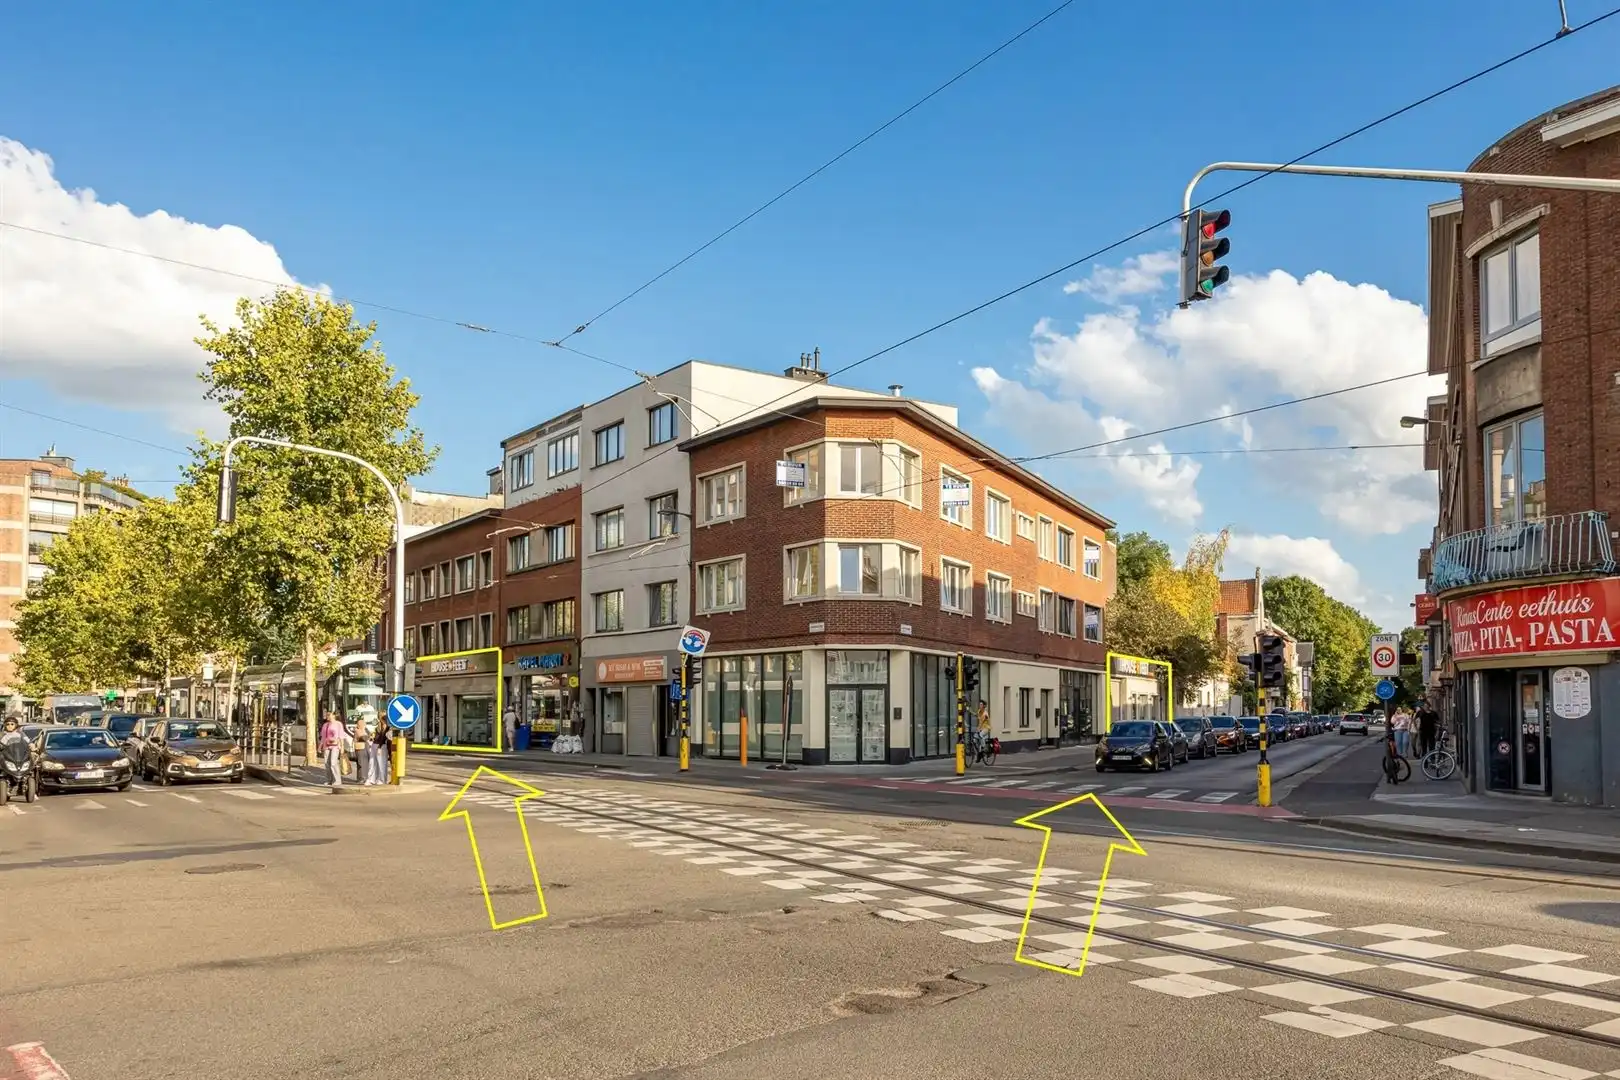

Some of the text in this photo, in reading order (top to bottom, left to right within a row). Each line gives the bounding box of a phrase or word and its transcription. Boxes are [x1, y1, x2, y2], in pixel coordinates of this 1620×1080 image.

[1519, 589, 1594, 618] eethuis
[1528, 617, 1616, 647] PASTA
[1378, 653, 1391, 662] 30
